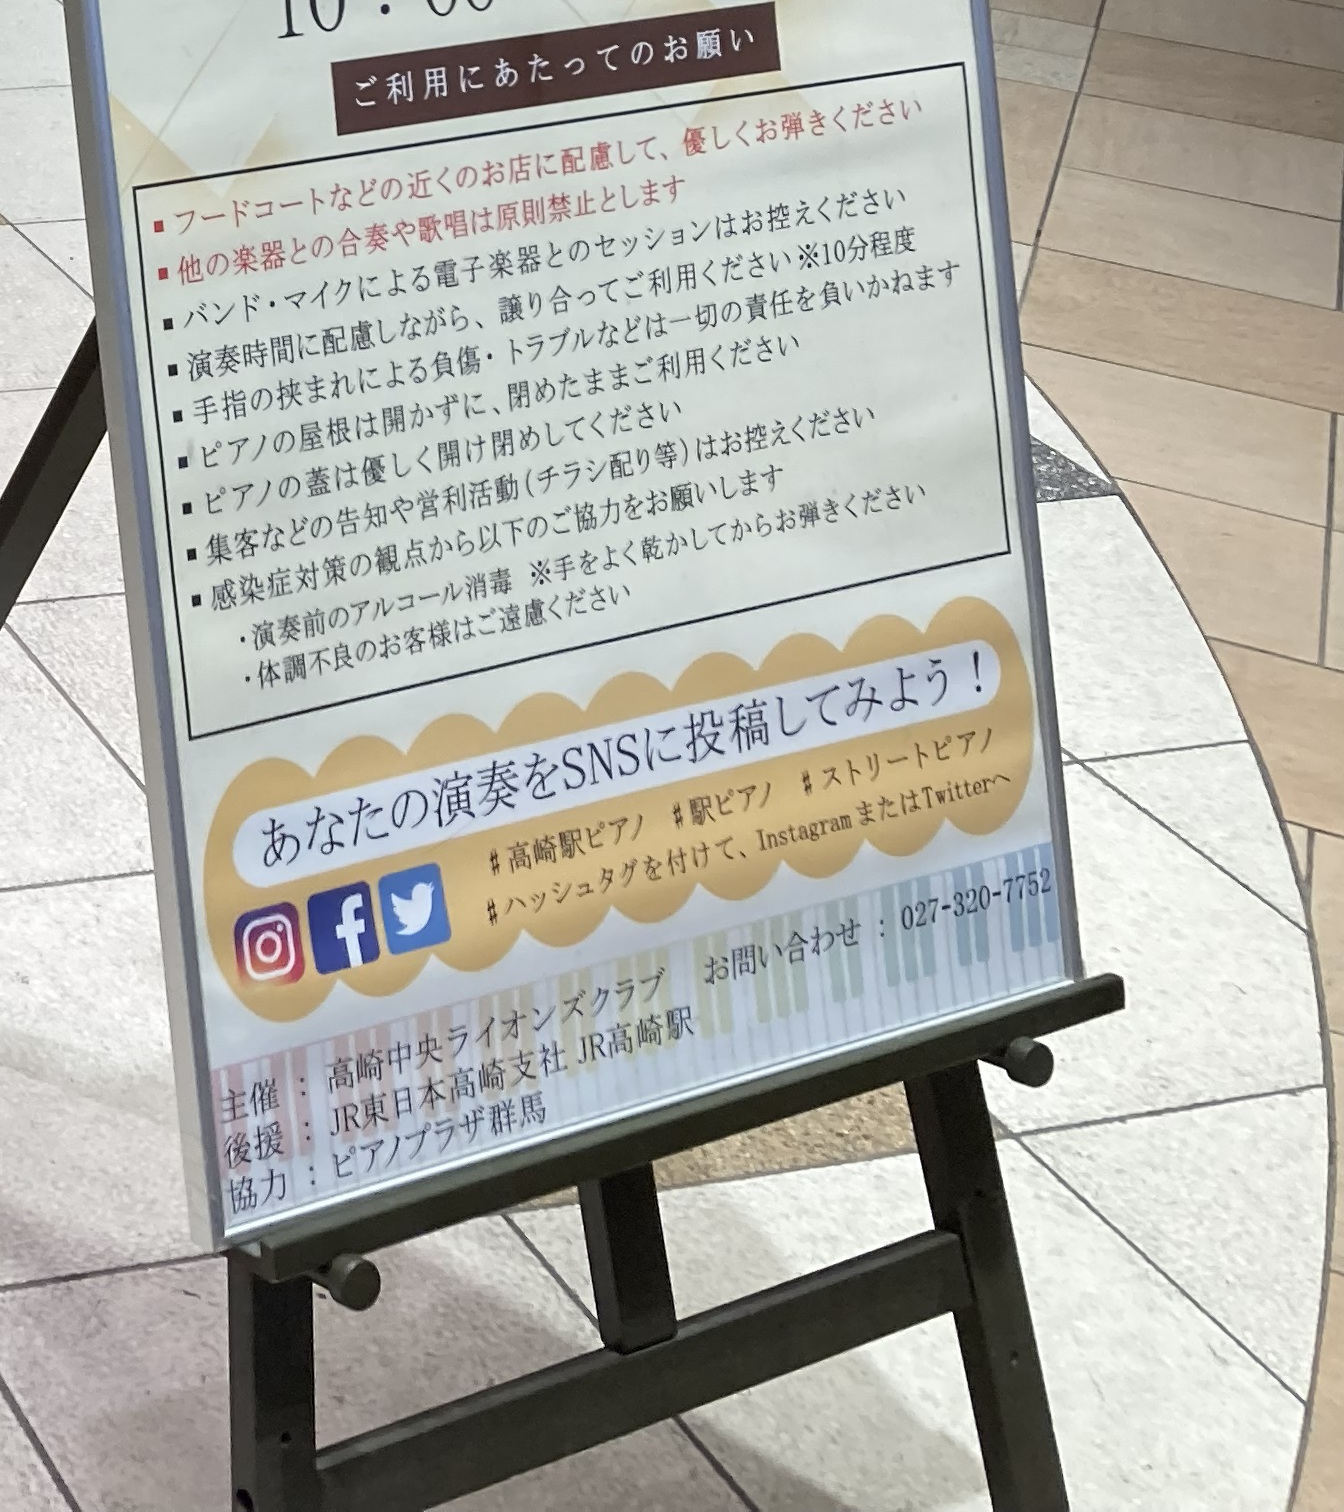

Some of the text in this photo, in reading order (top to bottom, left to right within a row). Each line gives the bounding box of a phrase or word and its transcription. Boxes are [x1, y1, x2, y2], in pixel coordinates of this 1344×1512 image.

[354, 25, 756, 110] ご利用にあたってのお願い
[900, 867, 1052, 932] 027-320-7752
